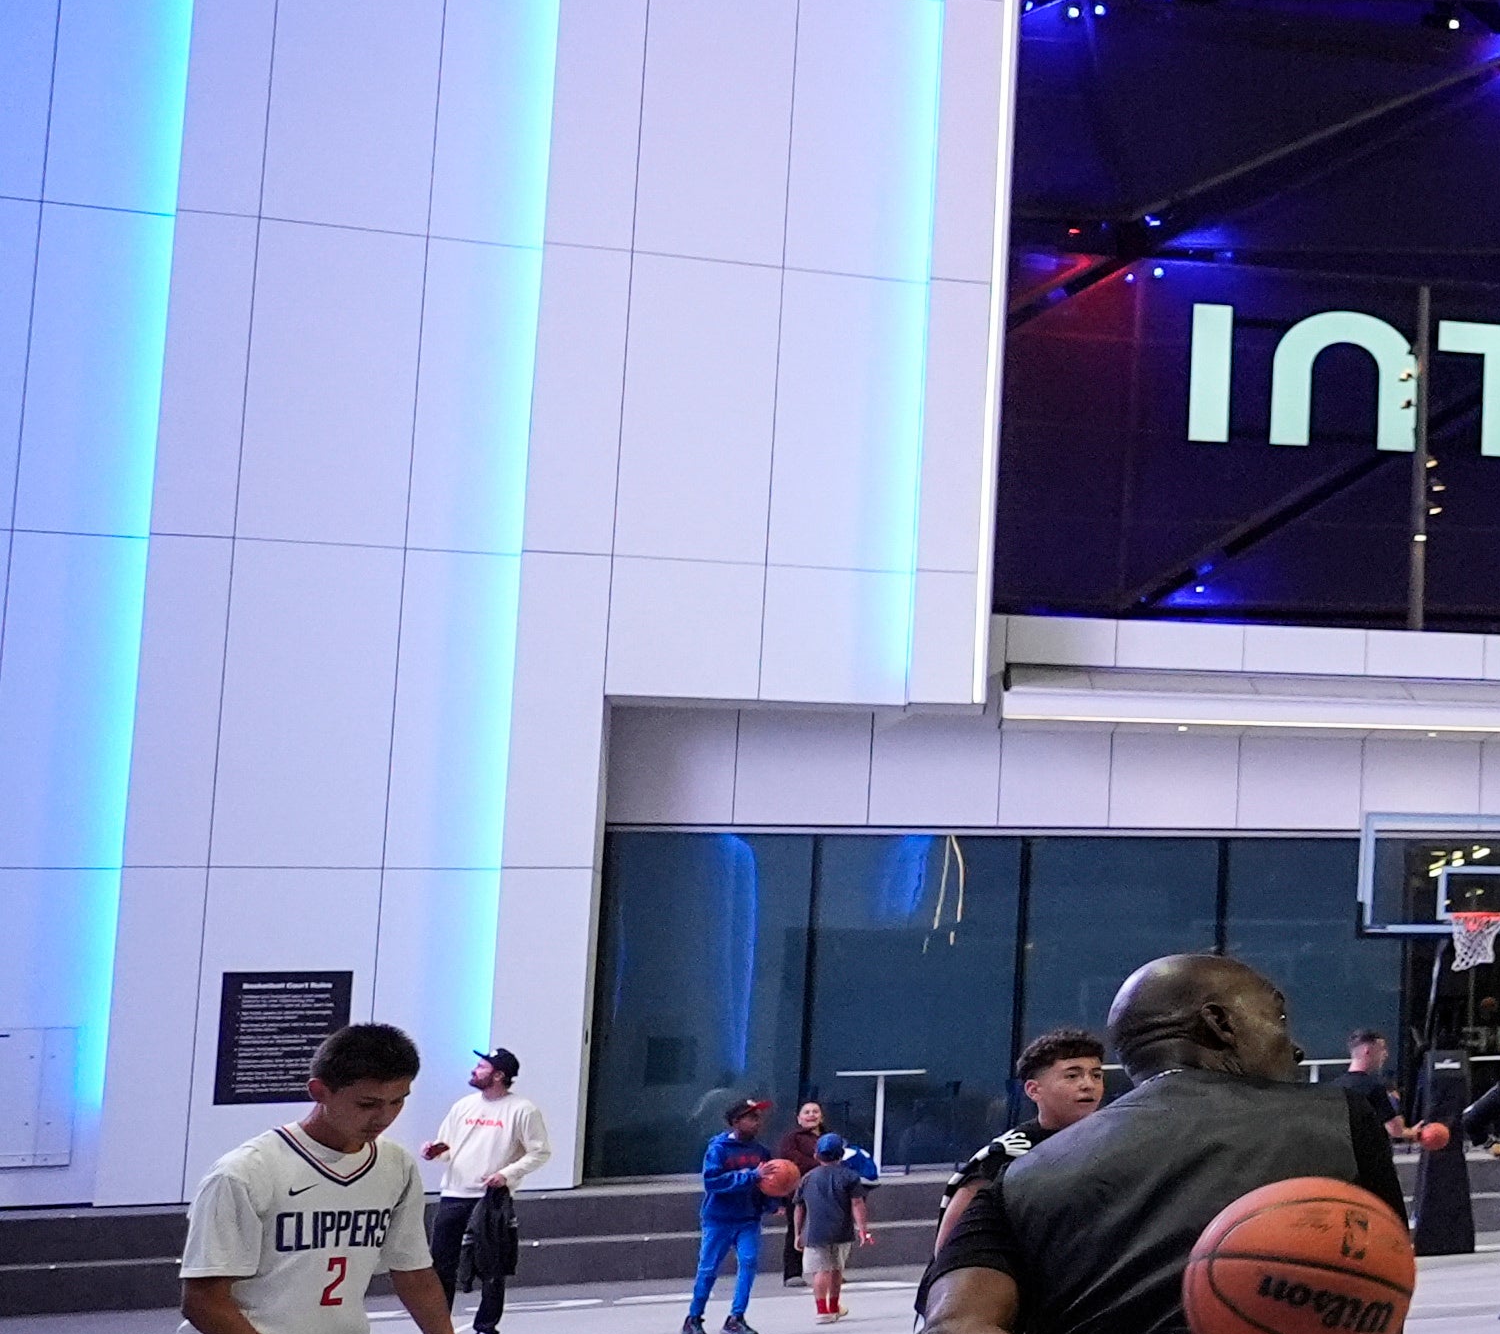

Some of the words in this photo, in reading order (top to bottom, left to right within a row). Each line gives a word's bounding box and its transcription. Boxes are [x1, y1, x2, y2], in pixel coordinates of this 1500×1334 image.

[465, 1118, 503, 1128] WNBA
[275, 1208, 391, 1253] CLIPPERS
[320, 1256, 347, 1307] 2
